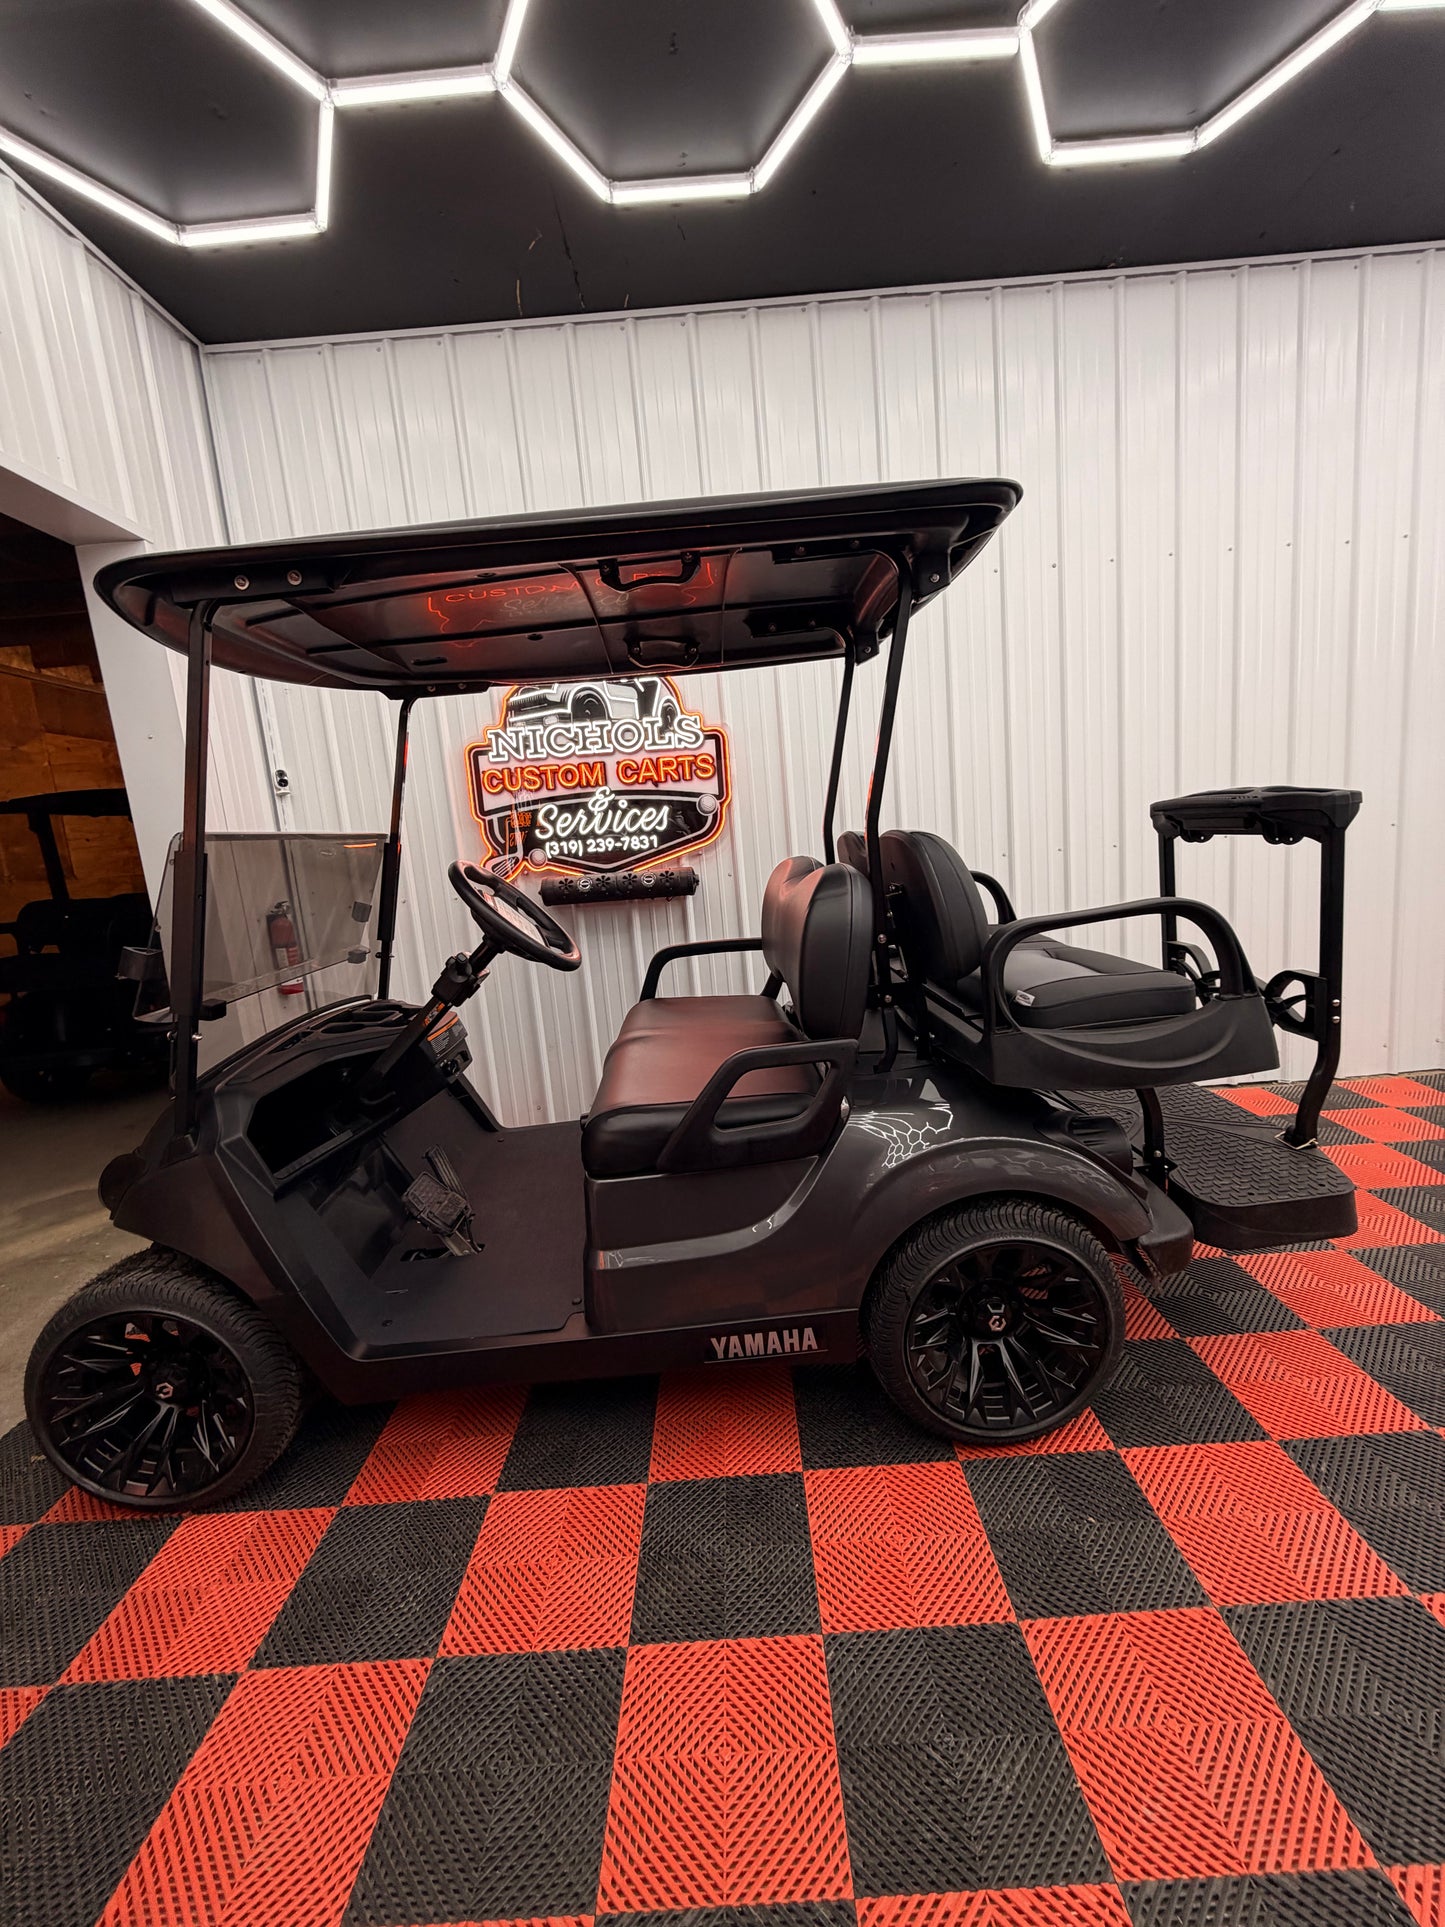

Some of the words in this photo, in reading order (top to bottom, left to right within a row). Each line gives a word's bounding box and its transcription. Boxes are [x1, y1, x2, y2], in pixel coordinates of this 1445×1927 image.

[487, 714, 705, 762] NICHOLS
[482, 761, 606, 795] CUSTOM
[616, 753, 717, 785] CARTS
[534, 799, 670, 840] Services
[588, 786, 616, 816] &
[545, 840, 583, 860] (319)
[587, 834, 658, 853] 239-7831
[710, 1327, 819, 1360] YAMAHA
